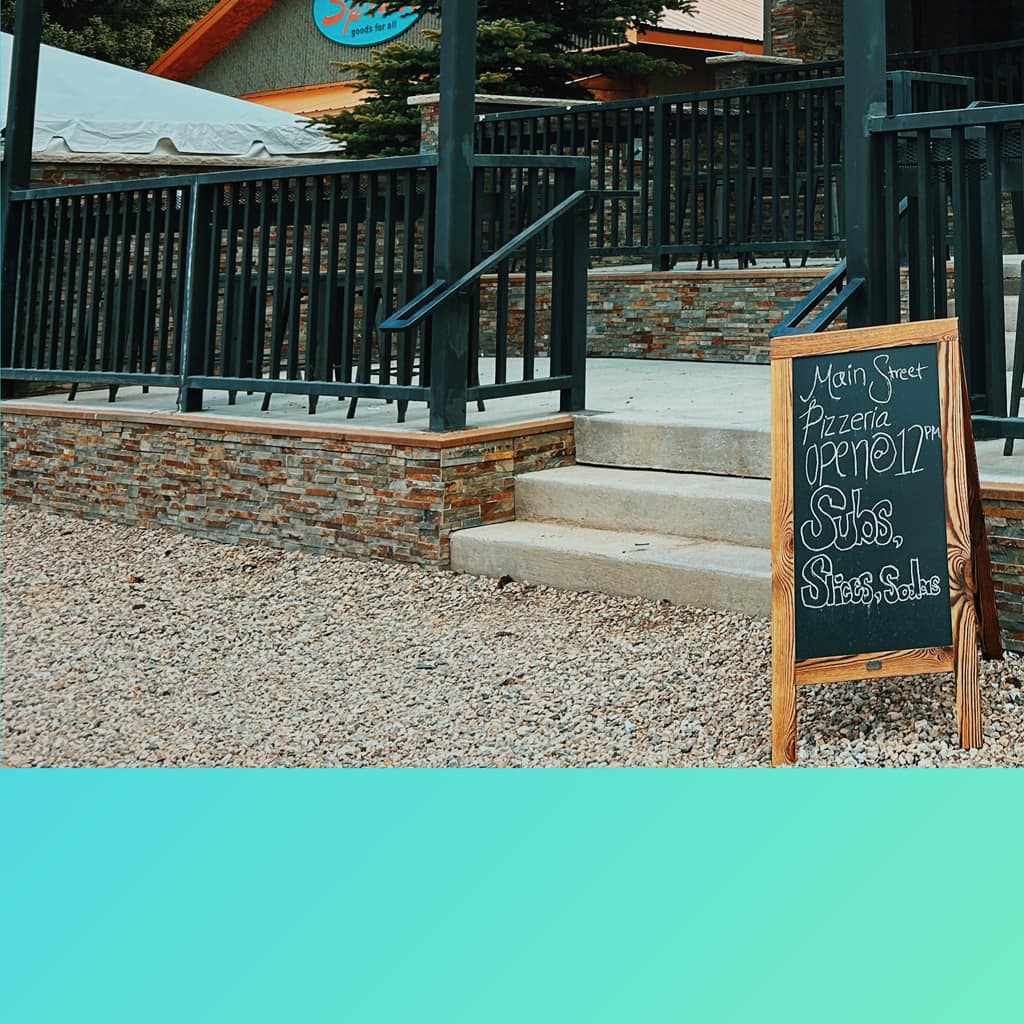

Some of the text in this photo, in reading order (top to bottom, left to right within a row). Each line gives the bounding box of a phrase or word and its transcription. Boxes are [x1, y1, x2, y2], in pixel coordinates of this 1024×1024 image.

[351, 20, 397, 38] goods for all
[799, 354, 928, 404] Main Street
[799, 398, 891, 446] Pizzeria
[800, 484, 904, 552] Subs,
